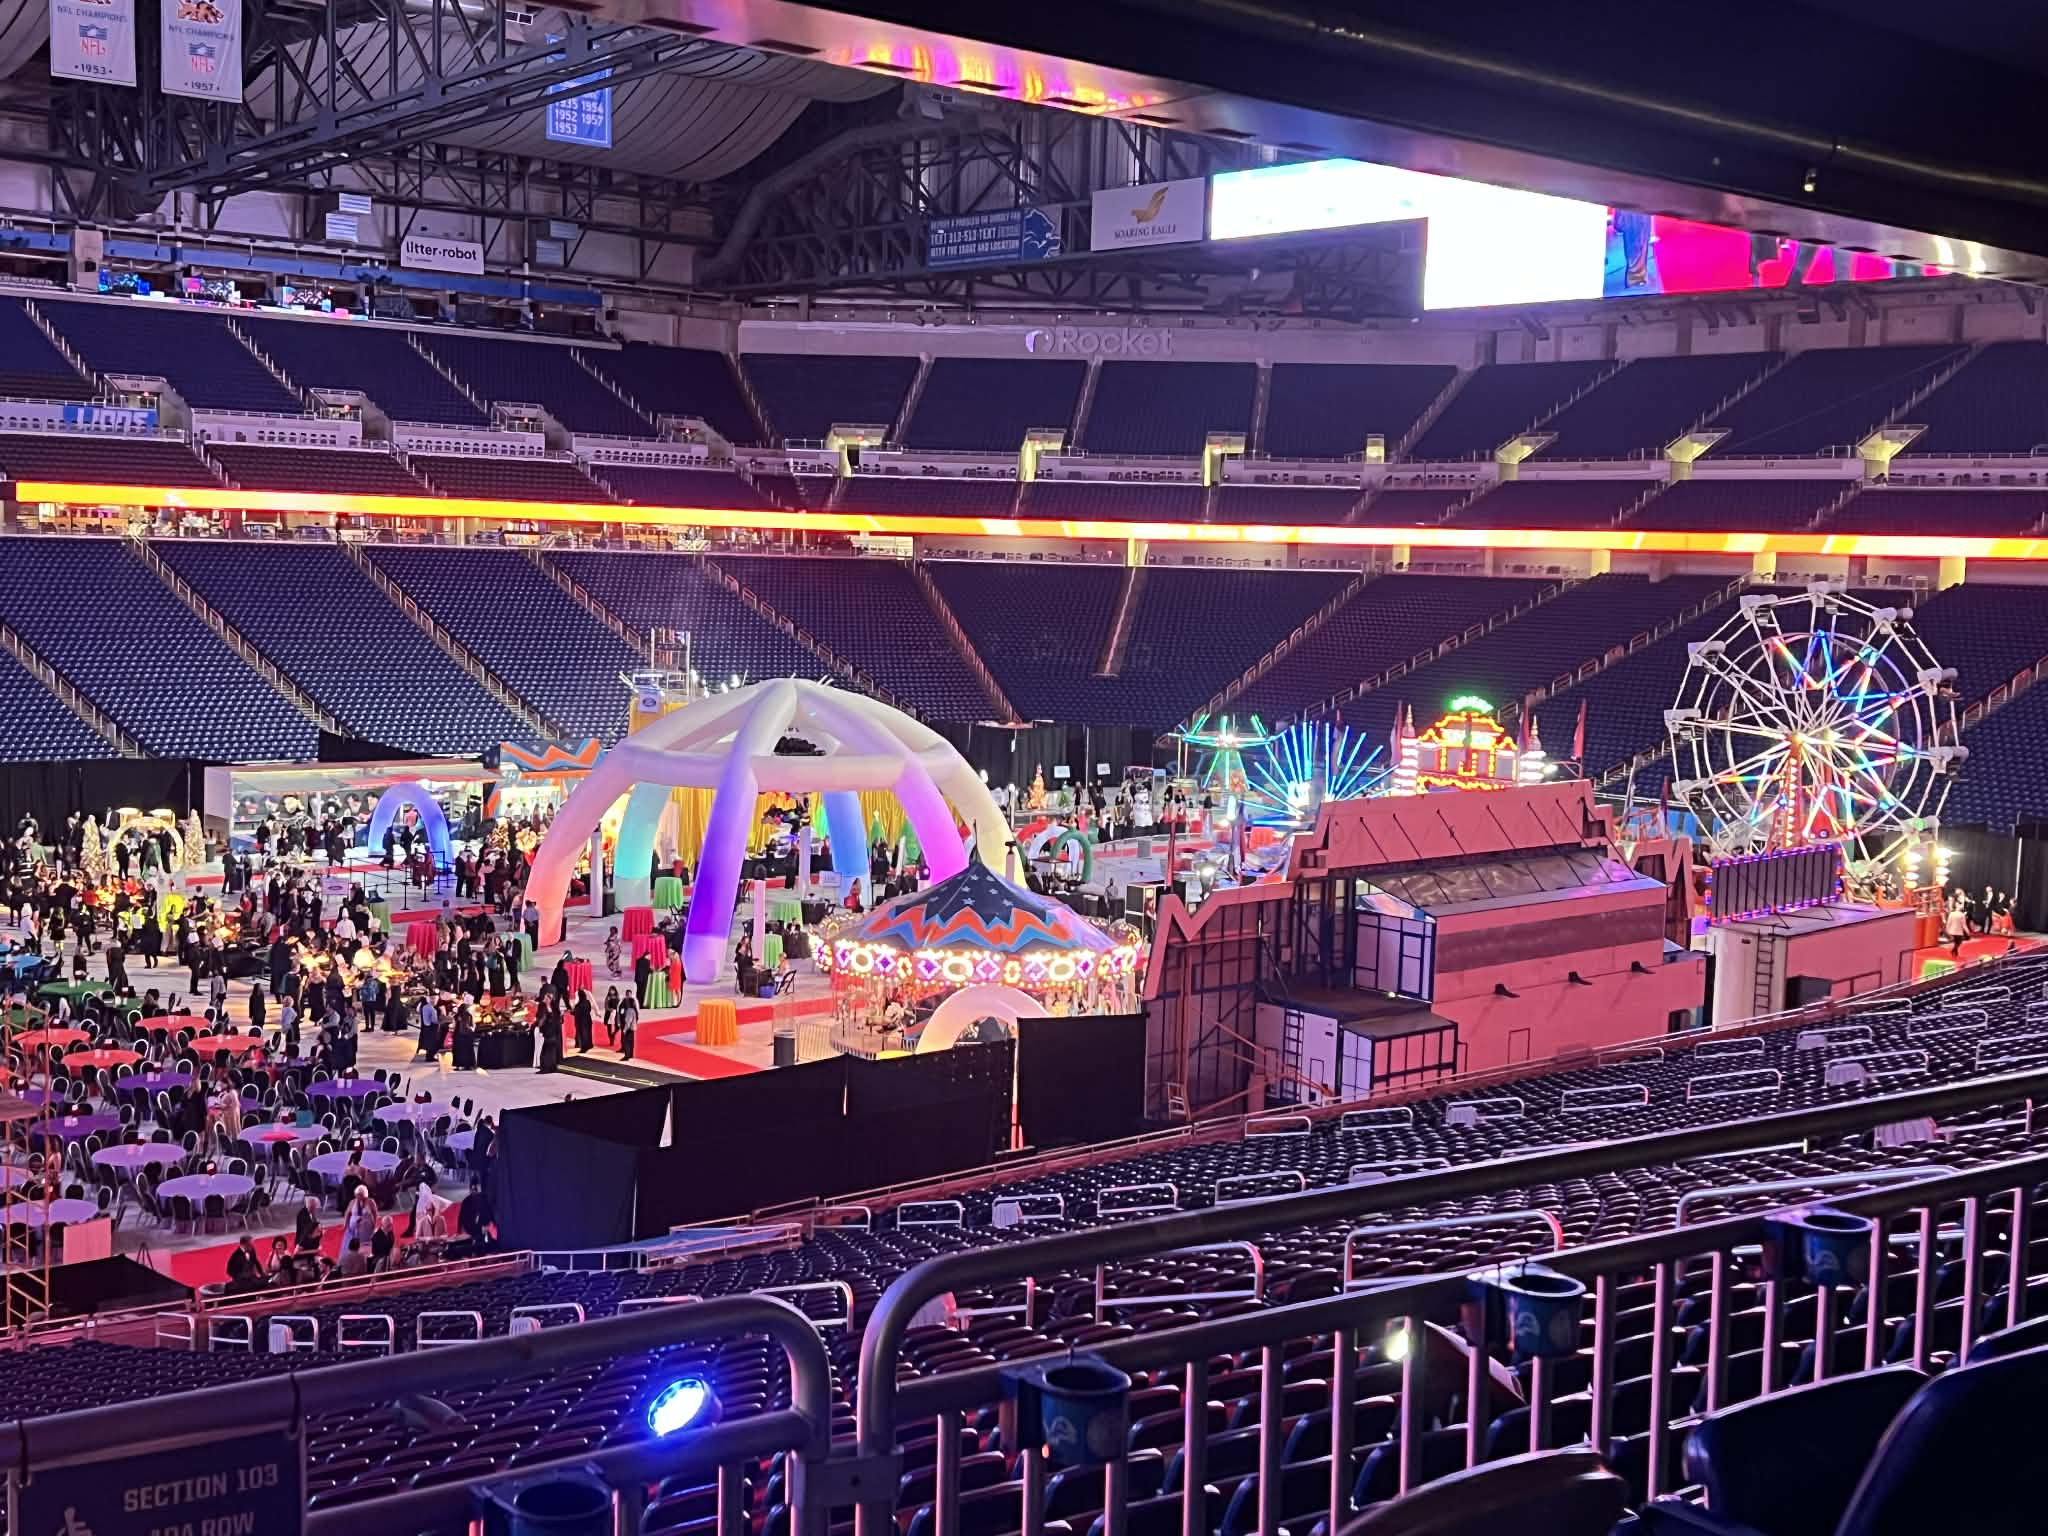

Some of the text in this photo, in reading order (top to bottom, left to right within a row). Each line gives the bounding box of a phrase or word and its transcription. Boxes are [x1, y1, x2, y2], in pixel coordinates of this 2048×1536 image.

[81, 63, 107, 75] 1953
[191, 82, 214, 92] 1957
[582, 101, 604, 114] 1954
[555, 108, 604, 126] 1952 1957
[555, 121, 577, 134] 1953
[1056, 326, 1175, 355] Rocket
[123, 1463, 279, 1513] SECTION 103
